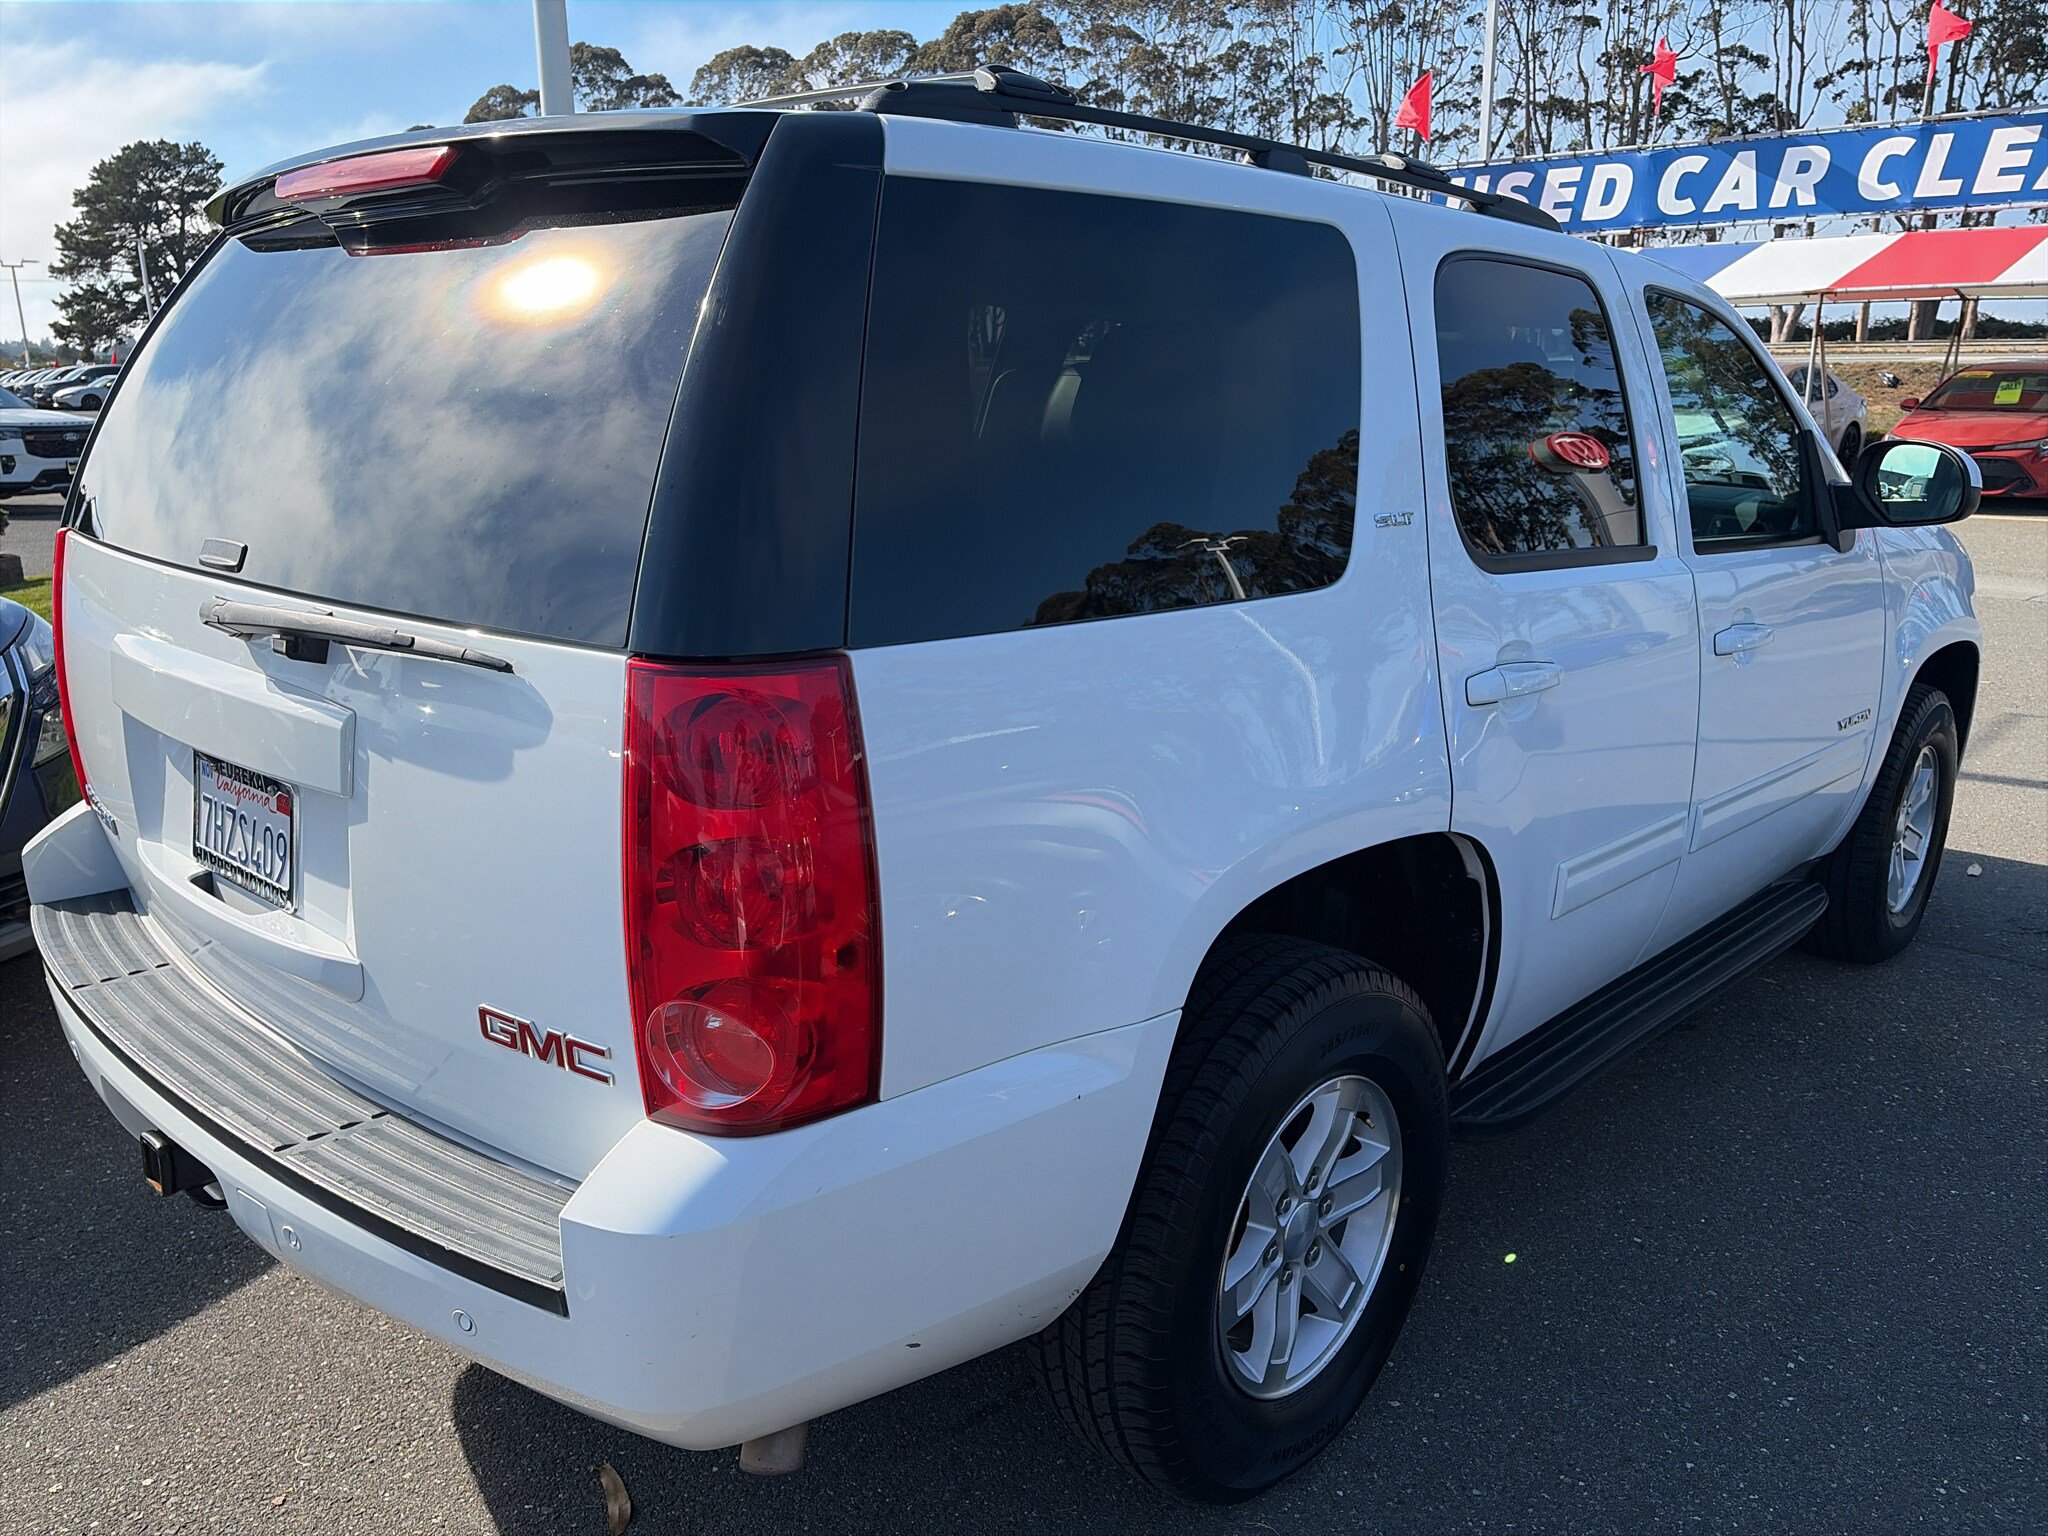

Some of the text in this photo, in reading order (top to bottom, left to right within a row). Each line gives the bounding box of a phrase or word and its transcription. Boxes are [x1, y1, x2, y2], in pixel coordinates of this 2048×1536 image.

[1657, 145, 1831, 216] CAR
[1374, 512, 1414, 528] SLT
[216, 774, 277, 814] California
[219, 761, 266, 793] EUREKA
[202, 795, 288, 882] 7HZS409
[478, 1003, 616, 1087] GMC
